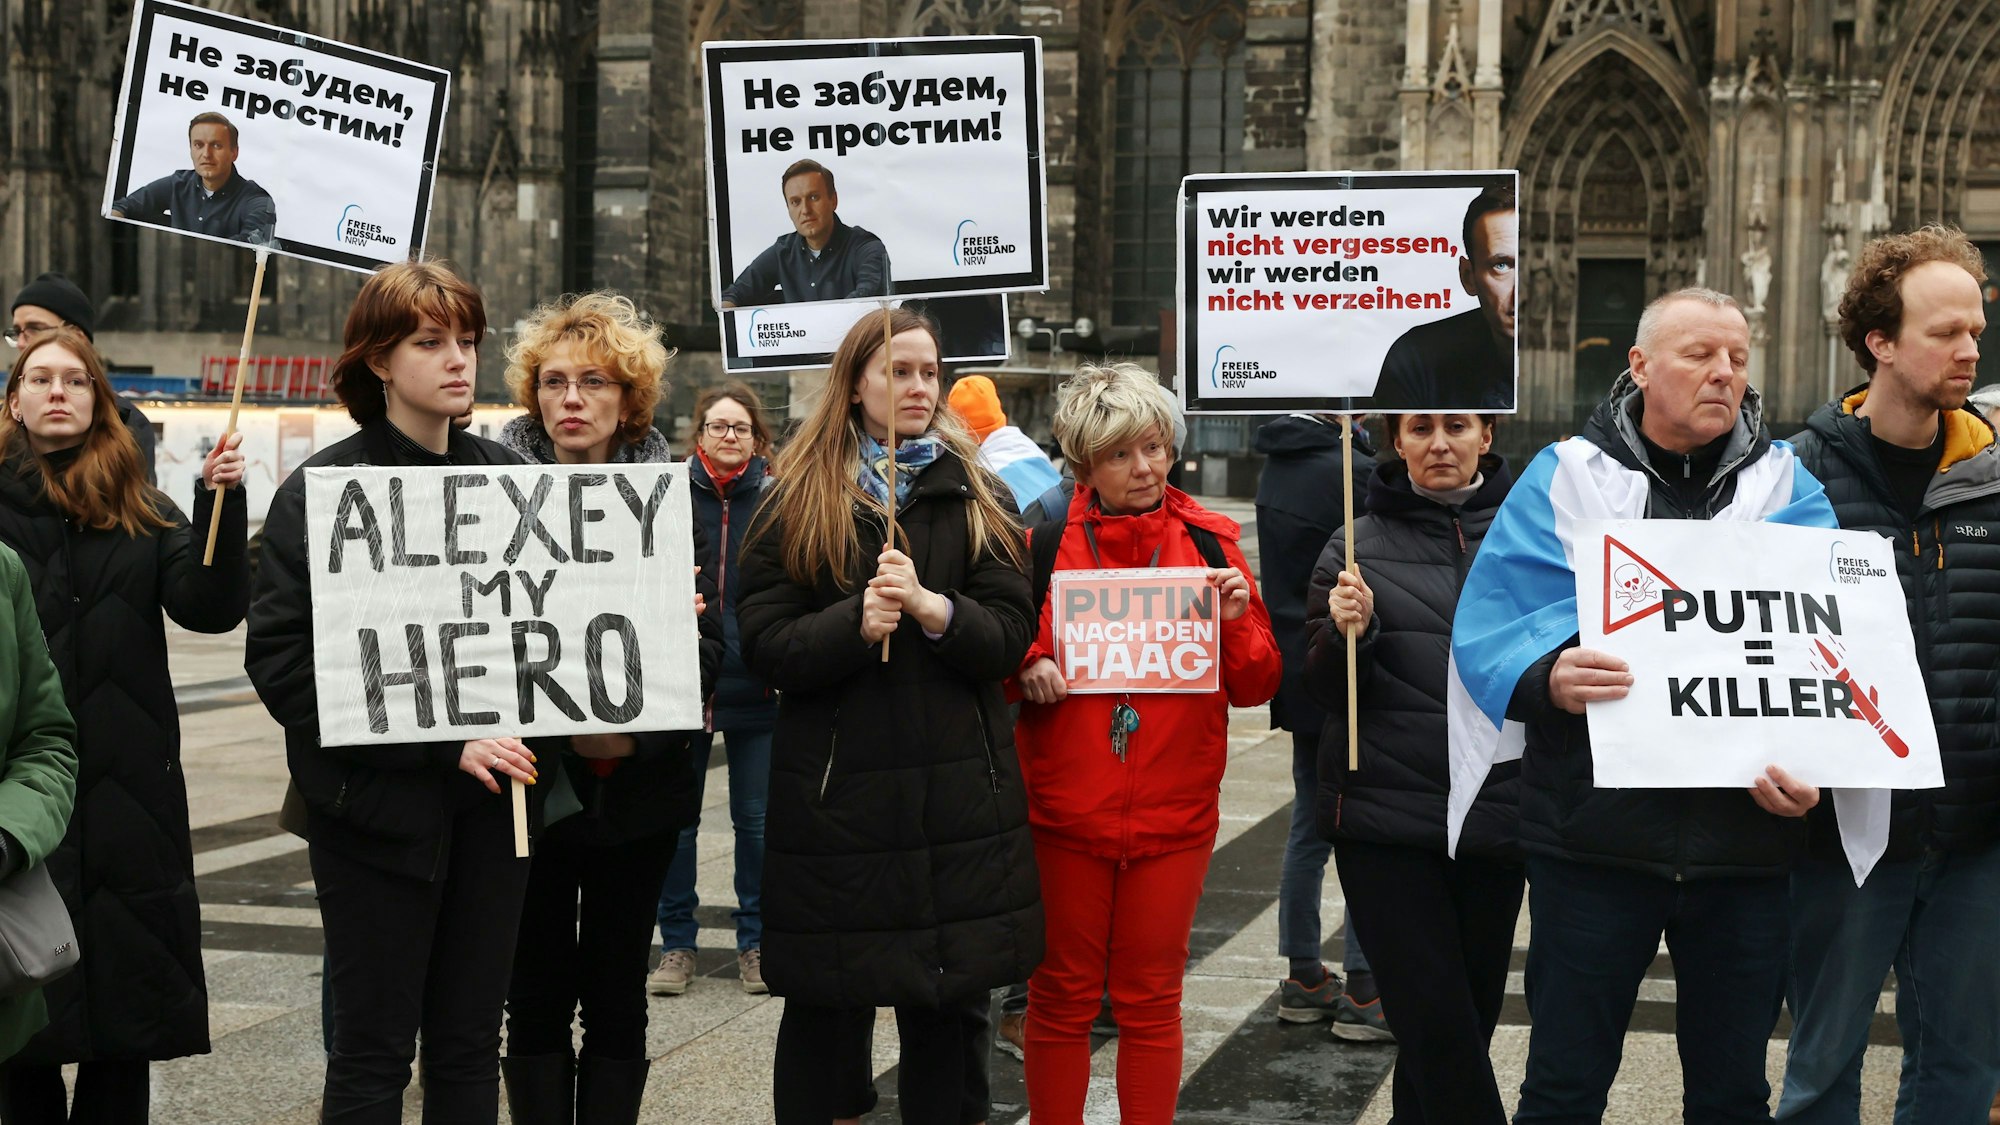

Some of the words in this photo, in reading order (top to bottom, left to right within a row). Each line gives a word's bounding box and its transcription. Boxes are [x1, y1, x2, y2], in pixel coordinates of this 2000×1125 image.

[169, 32, 223, 68] Не
[233, 53, 414, 121] забудем,
[743, 78, 800, 110] Не
[813, 70, 1007, 112] забудем,
[158, 72, 209, 101] не
[221, 86, 405, 148] простим!
[741, 126, 794, 154] не
[808, 111, 1002, 157] простим!
[347, 219, 382, 234] FREIES
[1207, 204, 1262, 229] Wir
[1270, 205, 1385, 228] werden
[345, 235, 368, 247] NRW
[346, 227, 397, 245] RUSSLAND
[963, 235, 999, 246] FREIES
[1207, 232, 1284, 256] nicht
[1293, 236, 1458, 260] vergessen,
[963, 244, 1016, 256] RUSSLAND
[963, 255, 987, 266] NRW
[1207, 260, 1256, 284] wir
[1264, 261, 1378, 283] werden
[1207, 288, 1284, 312] nicht
[1293, 286, 1451, 310] verzeihen!
[757, 322, 790, 331] FREIES
[758, 329, 807, 339] RUSSLAND
[758, 339, 780, 348] NRW
[1222, 361, 1259, 370] FREIES
[1222, 370, 1277, 379] RUSSLAND
[1222, 379, 1246, 389] NRW
[328, 473, 674, 574] ALEXEY
[1965, 525, 1988, 537] Rab
[1837, 557, 1870, 568] FREIES
[1838, 566, 1887, 577] RUSSLAND
[1839, 575, 1861, 585] NRW
[460, 568, 558, 619] MY
[1065, 586, 1213, 621] PUTIN
[1661, 588, 1843, 636] PUTIN
[1064, 621, 1147, 643] NACH
[1155, 621, 1213, 642] DEN
[1065, 642, 1213, 681] HAAG
[357, 612, 644, 734] HERO
[1667, 677, 1862, 719] KILLER
